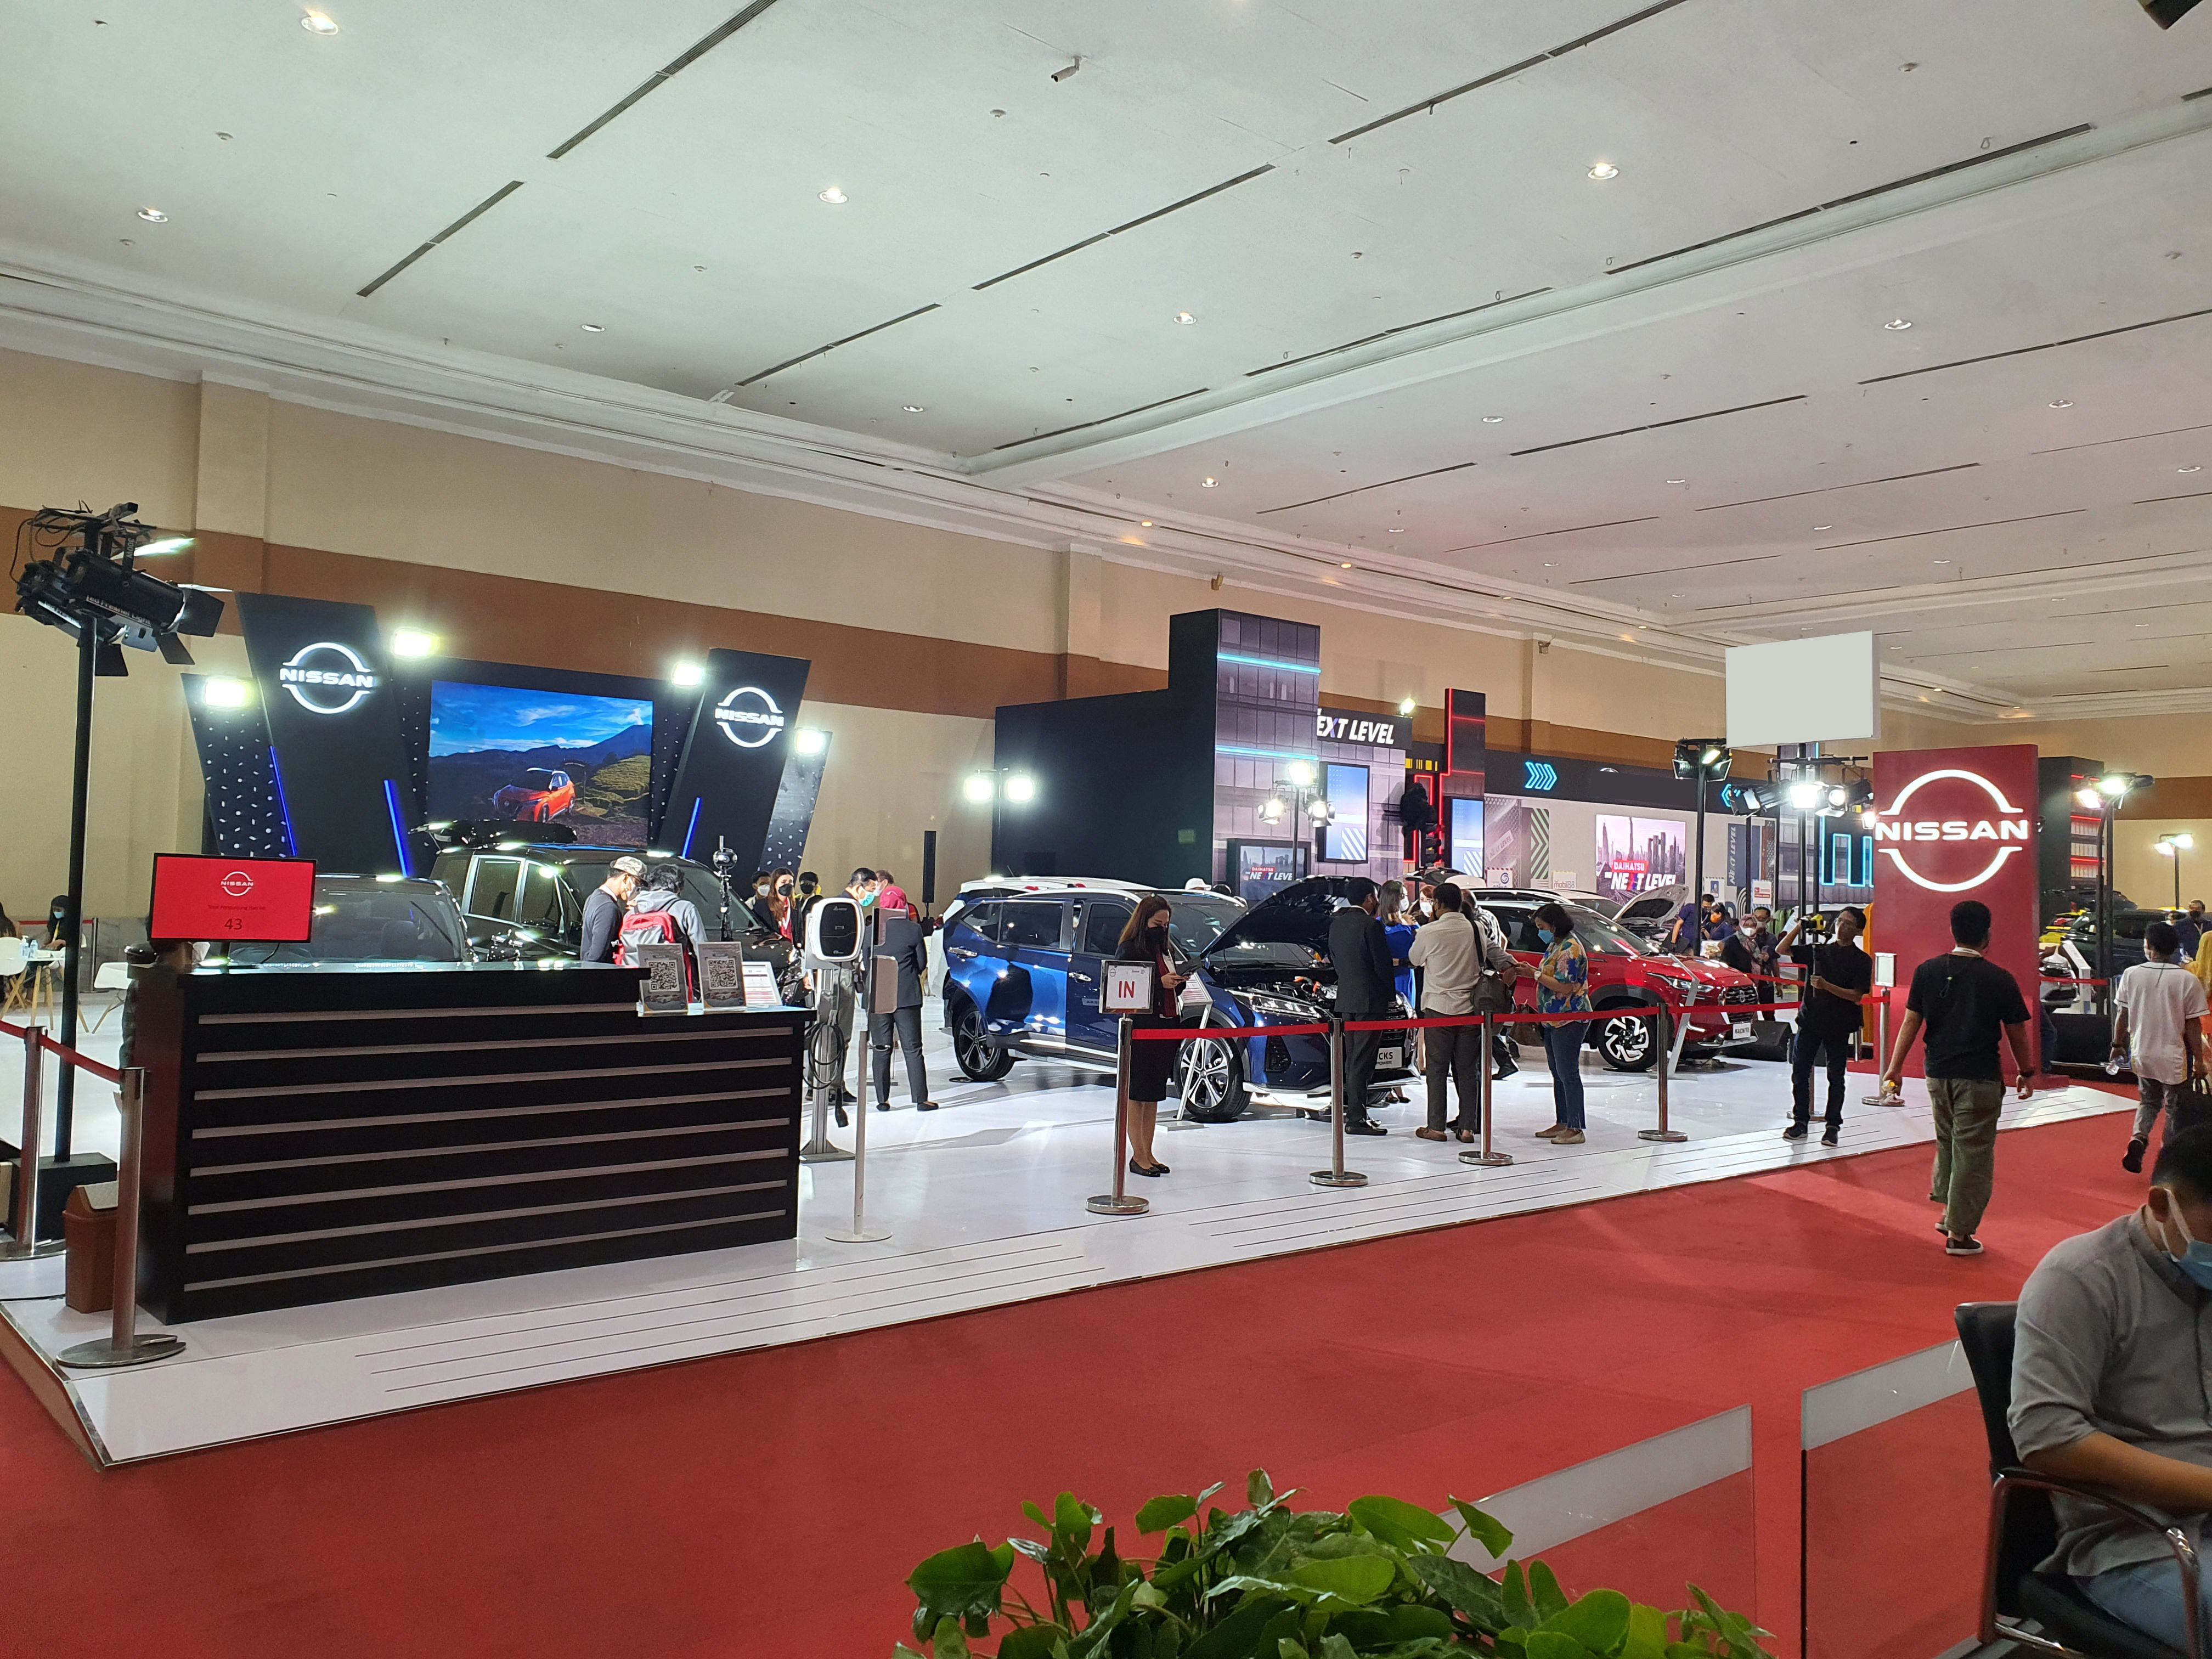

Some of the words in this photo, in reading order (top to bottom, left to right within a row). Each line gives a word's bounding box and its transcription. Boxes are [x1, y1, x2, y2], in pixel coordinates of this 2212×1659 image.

[280, 668, 373, 688] NISSAN
[715, 708, 784, 726] NISSAN
[1317, 716, 1348, 738] EXT
[1348, 720, 1394, 744] LEVEL
[1875, 820, 2028, 840] NISSAN
[1614, 862, 1645, 871] DAIHATSU
[1273, 872, 1293, 881] LEVE
[224, 918, 242, 930] 43
[1119, 980, 1135, 998] IN
[1379, 1052, 1393, 1060] CKS
